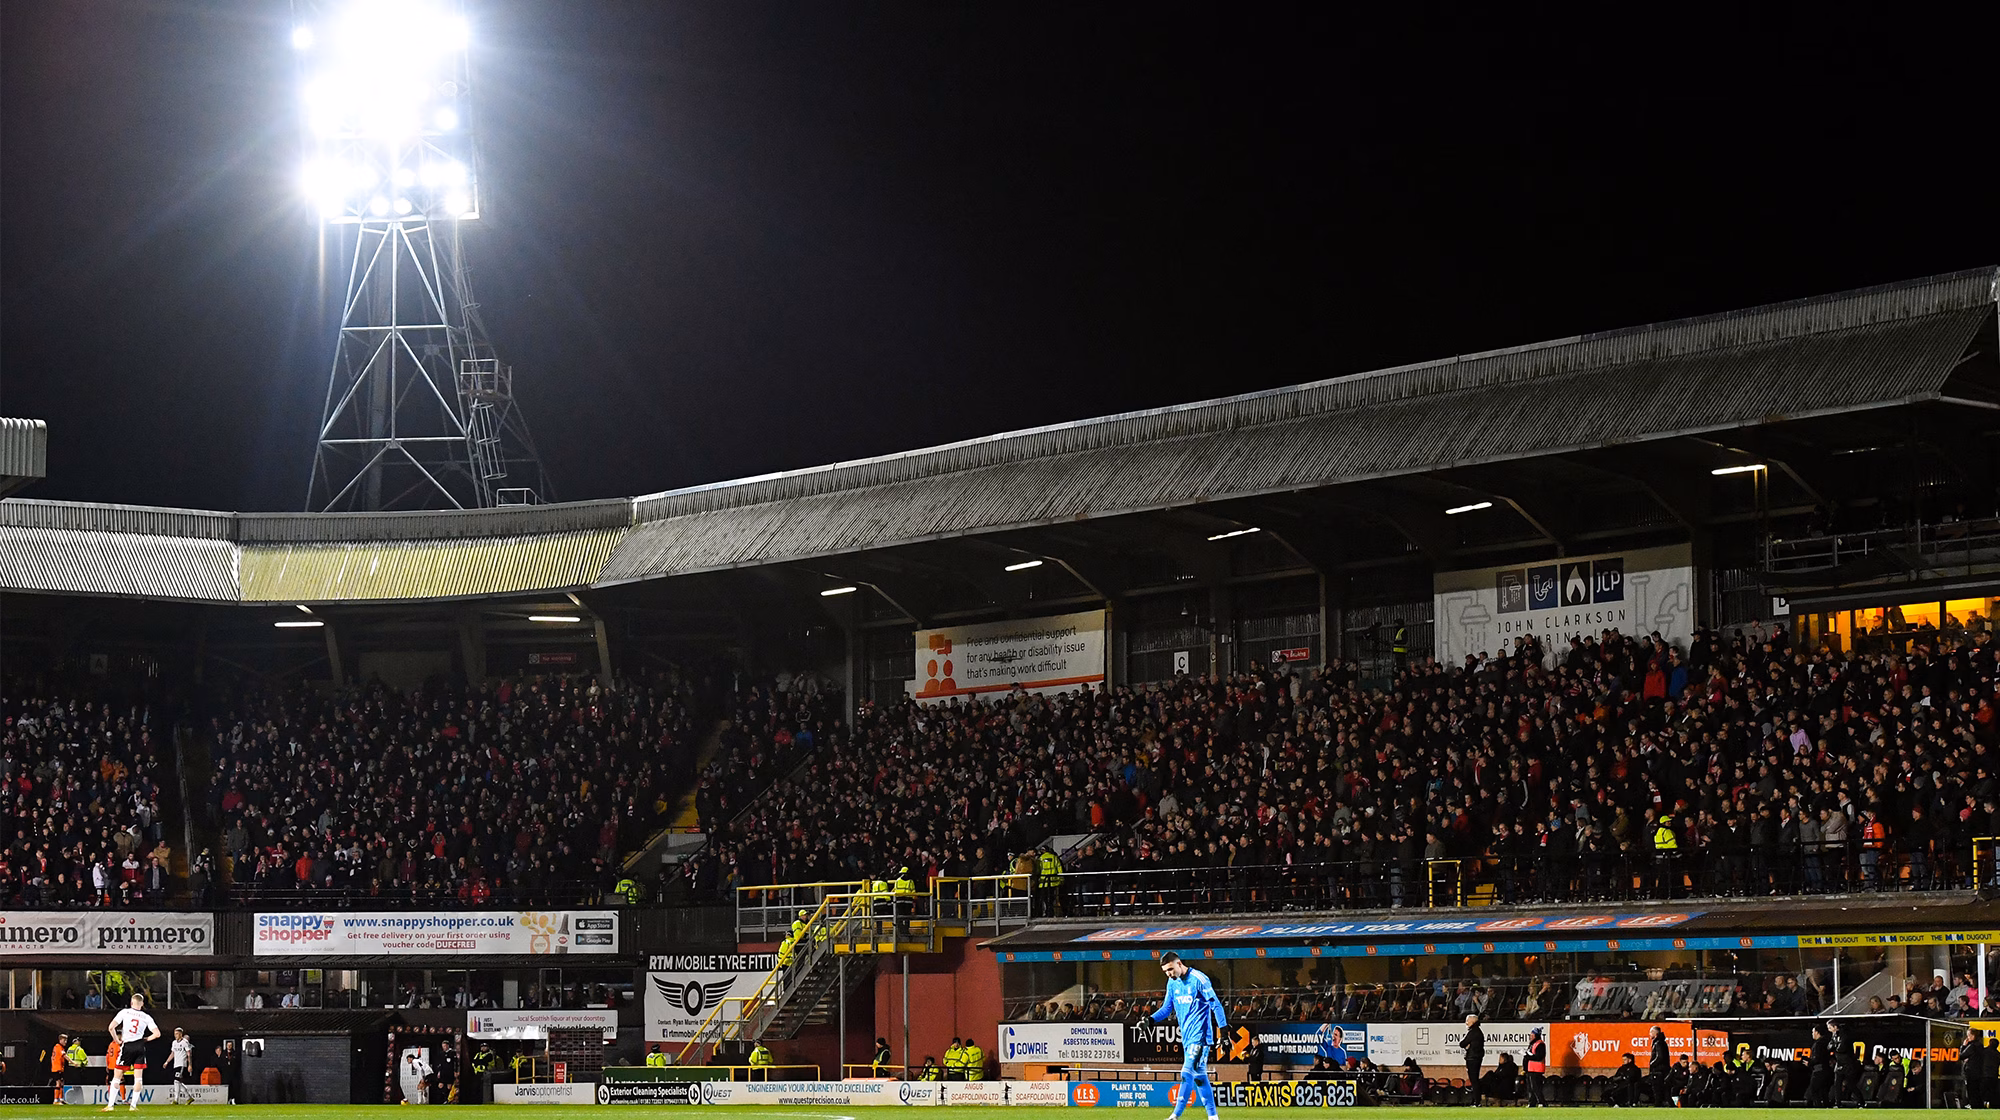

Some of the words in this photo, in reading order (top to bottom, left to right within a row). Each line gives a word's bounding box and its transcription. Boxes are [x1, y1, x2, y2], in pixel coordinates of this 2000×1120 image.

[1596, 570, 1621, 593] JCP
[1497, 619, 1533, 634] JOHN
[1545, 609, 1626, 629] CLARKSON
[966, 637, 982, 647] Free
[983, 635, 998, 646] and
[999, 630, 1045, 644] confidential
[1046, 625, 1076, 640] support
[966, 653, 977, 663] for
[978, 652, 992, 663] any
[1018, 649, 1027, 658] or
[1027, 643, 1063, 658] disability
[1064, 641, 1085, 653] issue
[1177, 656, 1185, 669] C
[966, 668, 988, 679] that's
[989, 665, 1016, 678] making
[1017, 663, 1037, 674] work
[1037, 659, 1067, 673] difficult
[259, 914, 324, 930] snappy
[343, 916, 514, 929] www.snappyshopper.co.uk
[1260, 925, 1338, 934] PLANT
[1332, 924, 1354, 932] &
[1356, 923, 1414, 932] TOOL
[1415, 921, 1477, 931] HIRE
[97, 917, 205, 949] primero
[259, 926, 331, 944] shopper
[363, 931, 379, 939] free
[381, 931, 413, 940] delivery
[446, 931, 464, 939] first
[465, 931, 487, 939] order
[488, 931, 511, 940] using
[415, 940, 435, 948] code
[436, 940, 476, 949] DUFCFREE
[649, 955, 673, 970] RTM
[675, 955, 716, 970] MOBILE
[718, 954, 747, 970] TYRE
[550, 1015, 565, 1023] liquor
[583, 1015, 606, 1023] doorstep
[129, 1018, 139, 1034] 3
[1070, 1027, 1103, 1035] DEMOLITION
[1063, 1038, 1090, 1046] ASBESTOS
[1090, 1038, 1116, 1046] REMOVAL
[1258, 1033, 1281, 1044] ROBIN
[1282, 1033, 1325, 1044] GALLOWAY
[1445, 1033, 1461, 1044] JON
[1503, 1033, 1547, 1043] ARCHITT
[1631, 1037, 1649, 1047] GET
[1016, 1042, 1048, 1055] GOWRIE
[1279, 1045, 1297, 1054] PURE
[1297, 1045, 1318, 1054] RADIO
[1592, 1039, 1620, 1053] DUTV
[1058, 1050, 1070, 1059] Tel:
[1070, 1050, 1092, 1059] 01382
[1094, 1050, 1120, 1059] 237854
[1872, 1044, 1959, 1062] QNNCASINO
[514, 1085, 572, 1097] Jarvisoptometrist
[609, 1086, 632, 1096] Exterior
[632, 1086, 657, 1098] Cleaning
[658, 1086, 688, 1098] Specialists
[745, 1084, 788, 1093] "ENGINEERING
[788, 1084, 804, 1093] YOUR
[805, 1084, 833, 1093] JOURNEY
[834, 1084, 844, 1093] TO
[843, 1084, 884, 1093] EXCELLENCE"
[1111, 1083, 1129, 1091] PLANT
[1130, 1083, 1136, 1091] &
[1136, 1083, 1154, 1091] TOOL
[1, 1094, 40, 1104] dee.co.uk
[703, 1083, 732, 1104] QUEST
[899, 1082, 932, 1105] QUEST
[950, 1093, 988, 1101] SCAFFOLDING
[988, 1093, 999, 1101] LTD
[1015, 1093, 1055, 1101] SCAFFOLDING
[1055, 1093, 1066, 1101] LTD
[1076, 1088, 1095, 1100] Y.E.S.
[1119, 1092, 1133, 1100] HIRE
[1134, 1092, 1147, 1100] FOR
[1296, 1086, 1326, 1107] 825
[1328, 1086, 1354, 1107] 825
[778, 1095, 851, 1105] www.questprecision.co.uk
